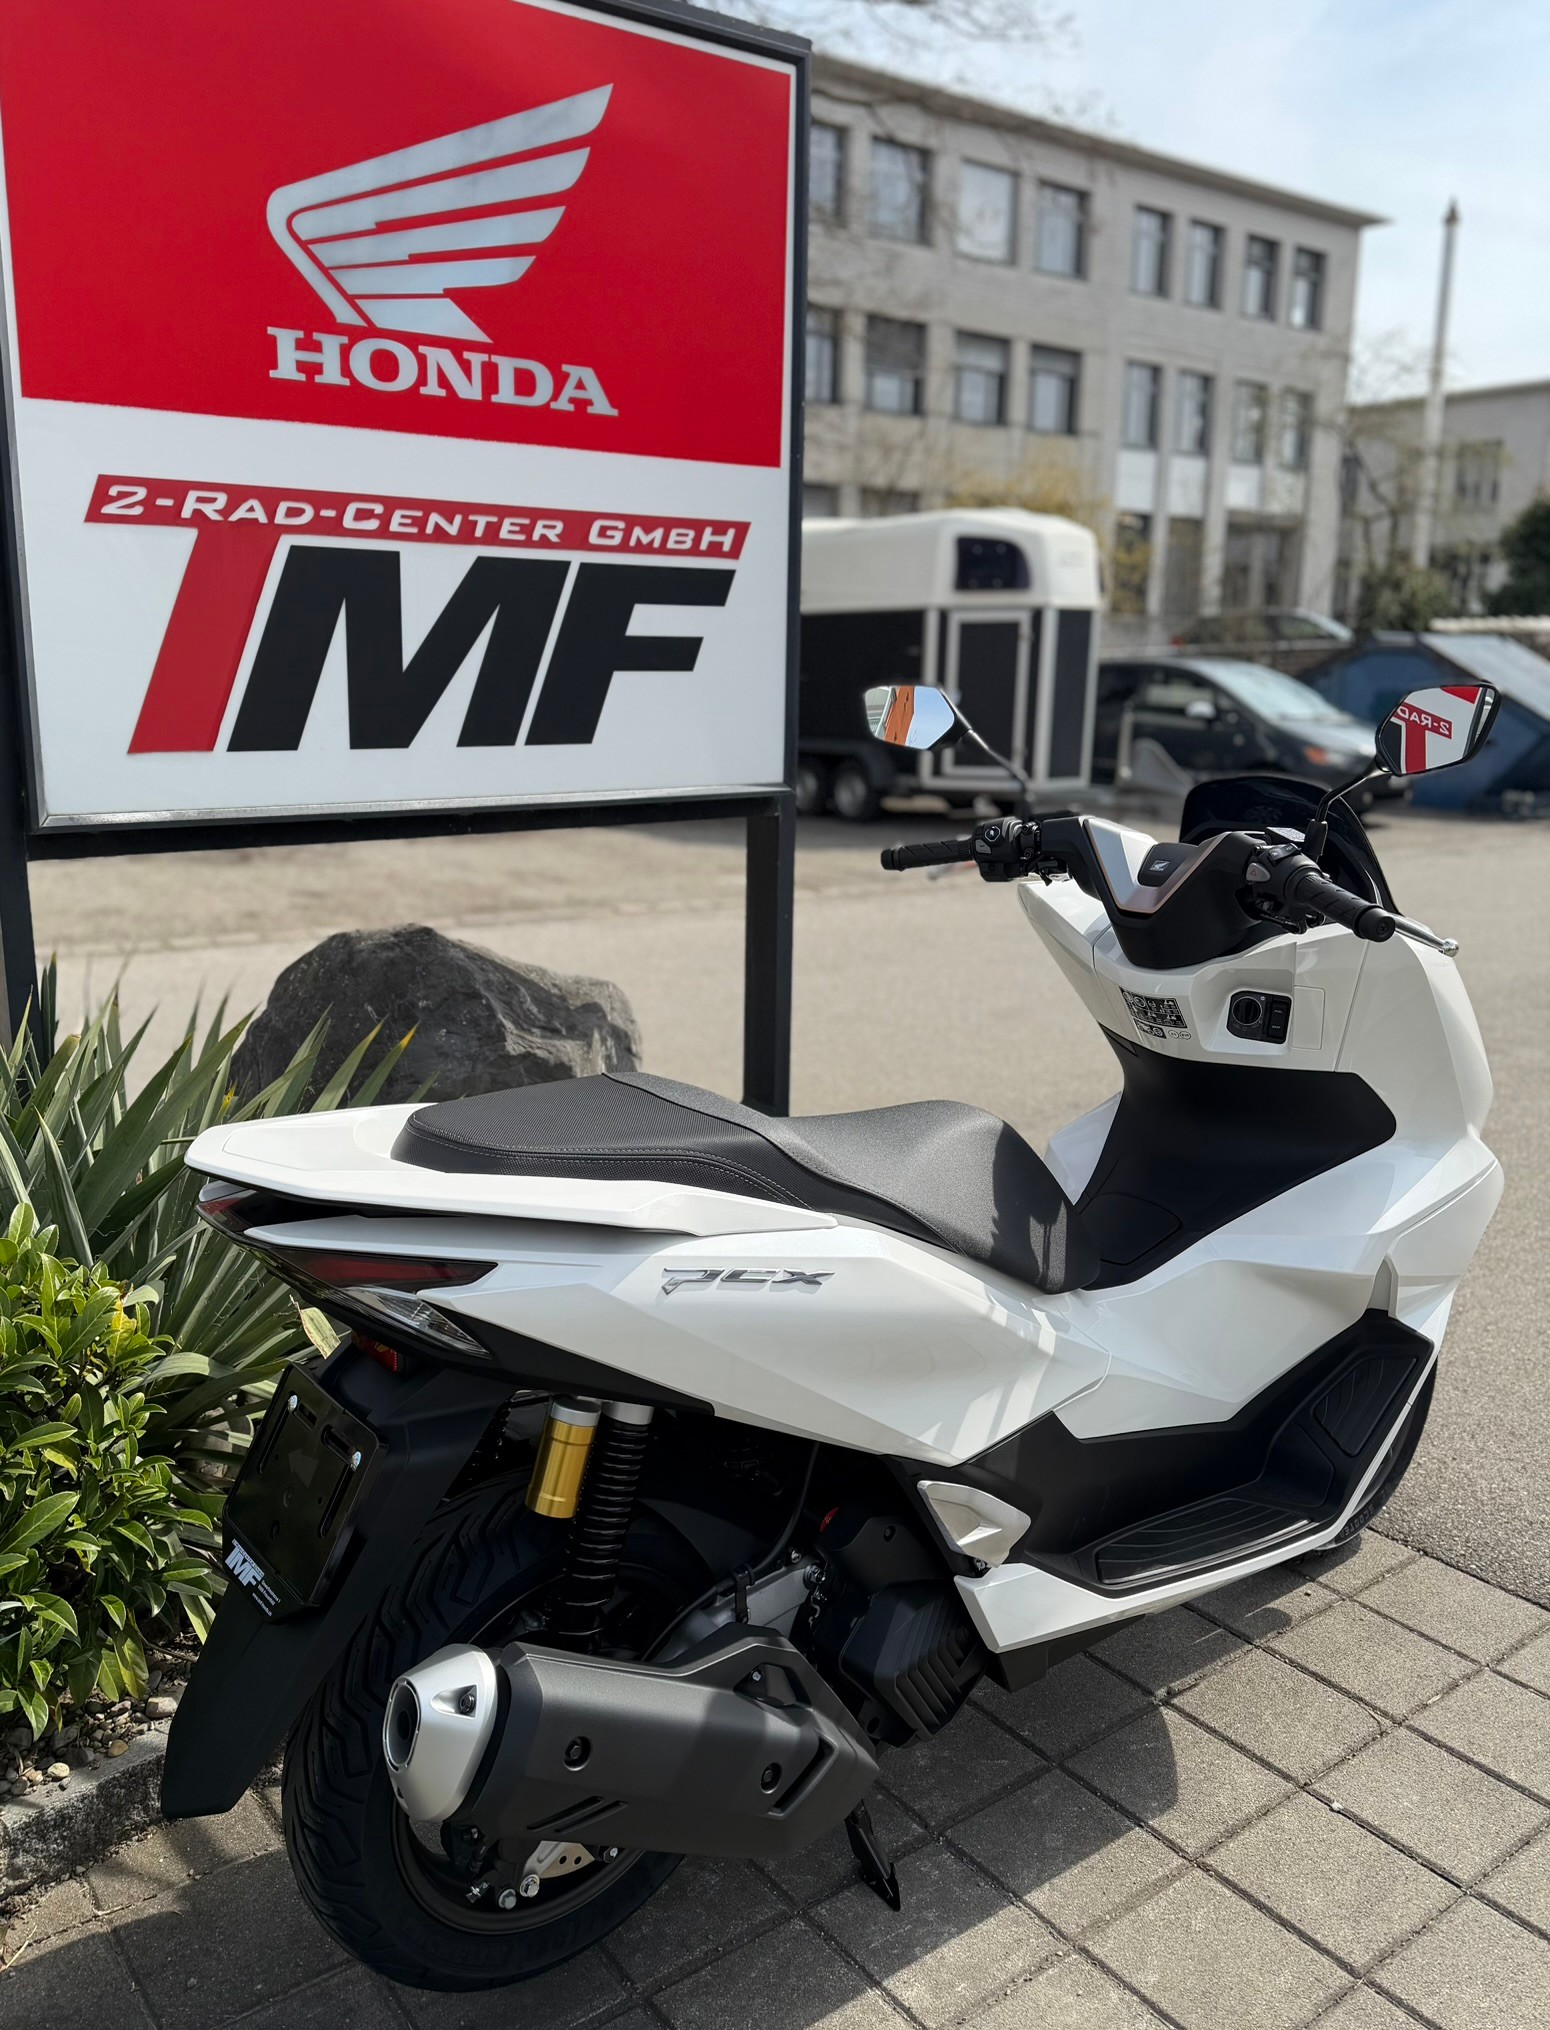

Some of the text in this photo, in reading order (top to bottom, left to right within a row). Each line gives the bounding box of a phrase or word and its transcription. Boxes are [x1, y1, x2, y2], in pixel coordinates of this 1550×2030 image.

[267, 326, 619, 416] HONDA
[118, 522, 738, 753] TMF
[661, 1267, 836, 1296] PCX
[225, 1543, 264, 1586] TMF
